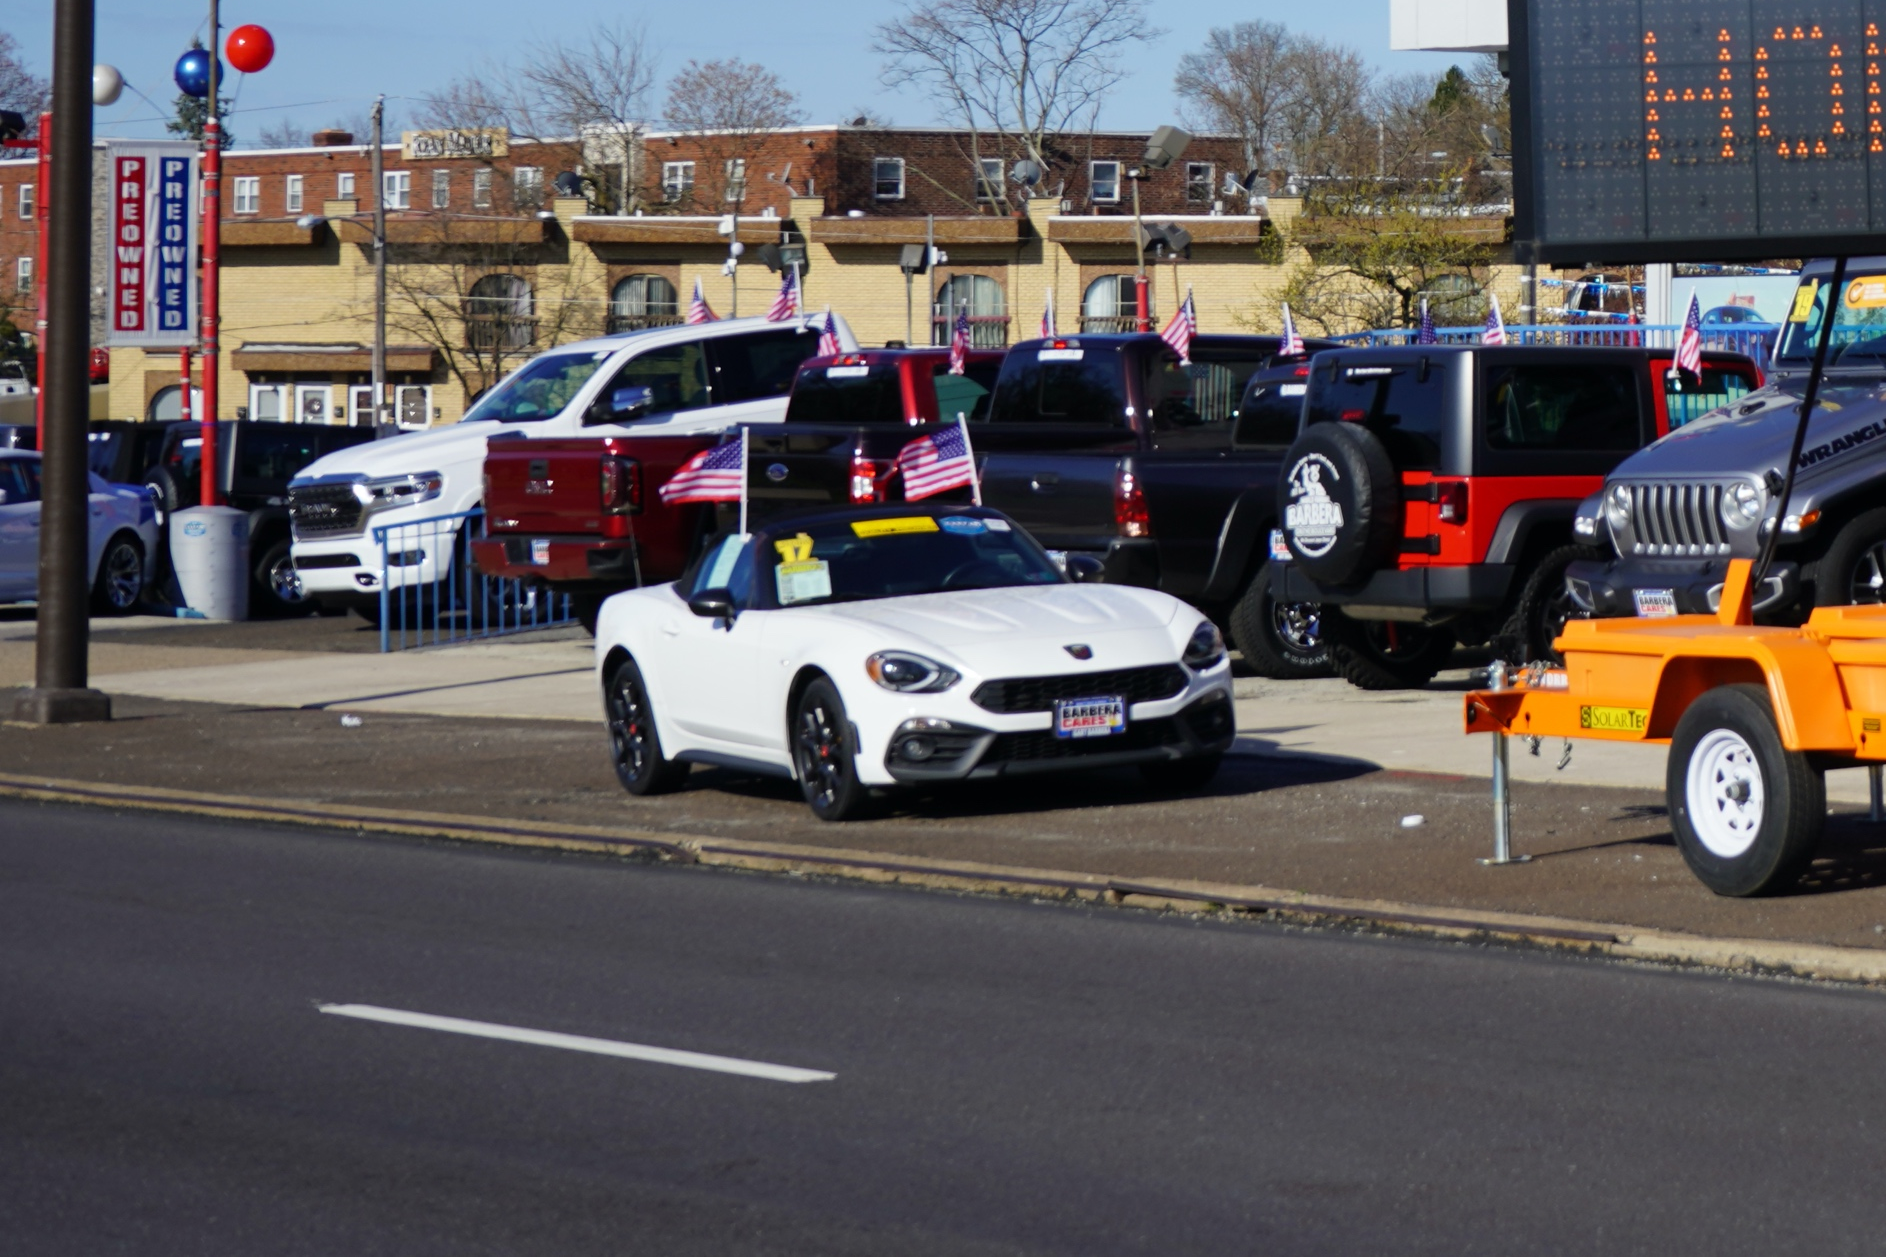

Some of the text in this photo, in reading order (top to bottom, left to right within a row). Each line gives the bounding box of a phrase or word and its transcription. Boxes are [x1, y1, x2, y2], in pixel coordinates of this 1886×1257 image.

[117, 159, 143, 328] PREOWNED
[161, 159, 186, 328] PREOWNED
[1286, 503, 1344, 529] BARBERA
[1639, 596, 1674, 605] BARBERA
[1062, 704, 1122, 719] BARBERA
[1062, 715, 1107, 728] CARES
[1593, 707, 1648, 729] SOLARTEC
